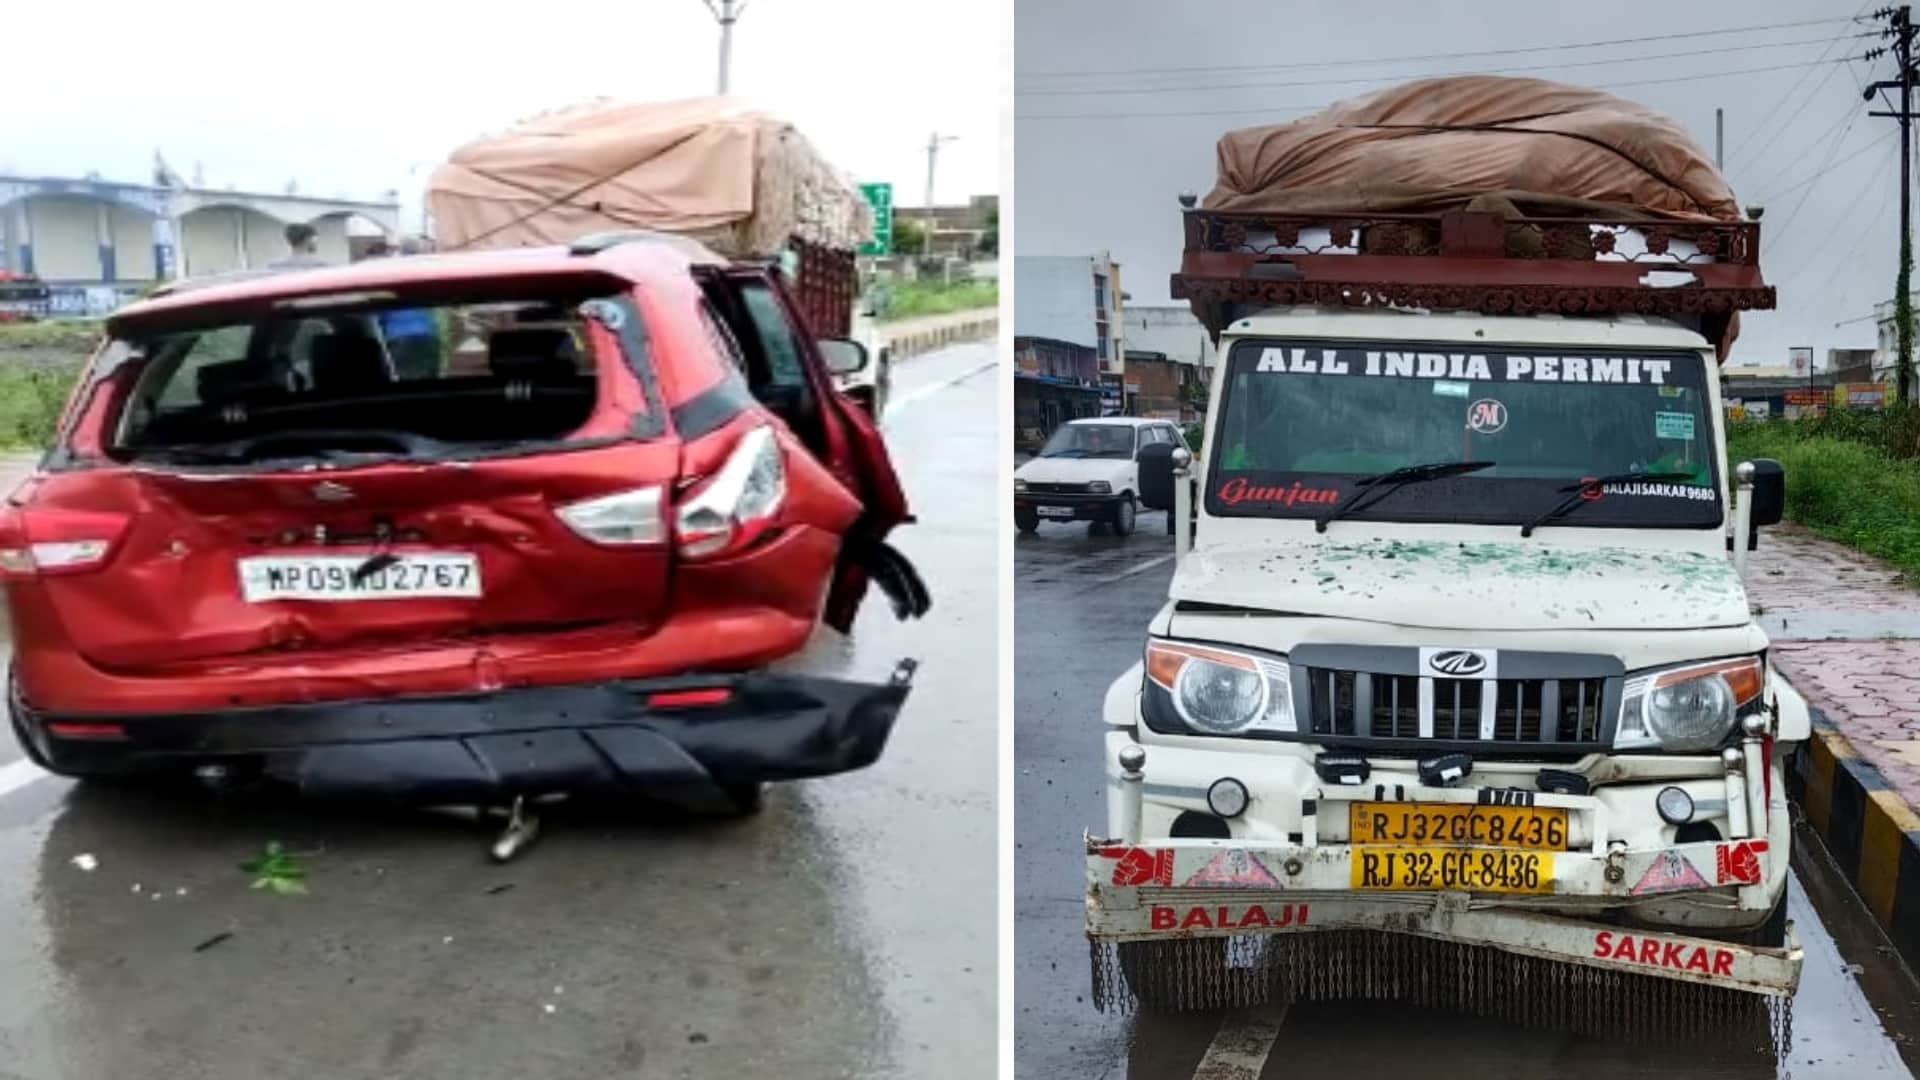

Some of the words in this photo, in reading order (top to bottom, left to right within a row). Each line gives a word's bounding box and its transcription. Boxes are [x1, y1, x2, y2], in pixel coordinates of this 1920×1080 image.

[1256, 348, 1349, 375] ALL
[1365, 351, 1491, 380] INDIA
[1506, 355, 1671, 384] PERMIT
[1218, 478, 1340, 507] Gunjan
[1373, 813, 1563, 846] RJ32GC8436
[1150, 904, 1310, 930] BALAJI
[1593, 931, 1735, 977] SARKAR
